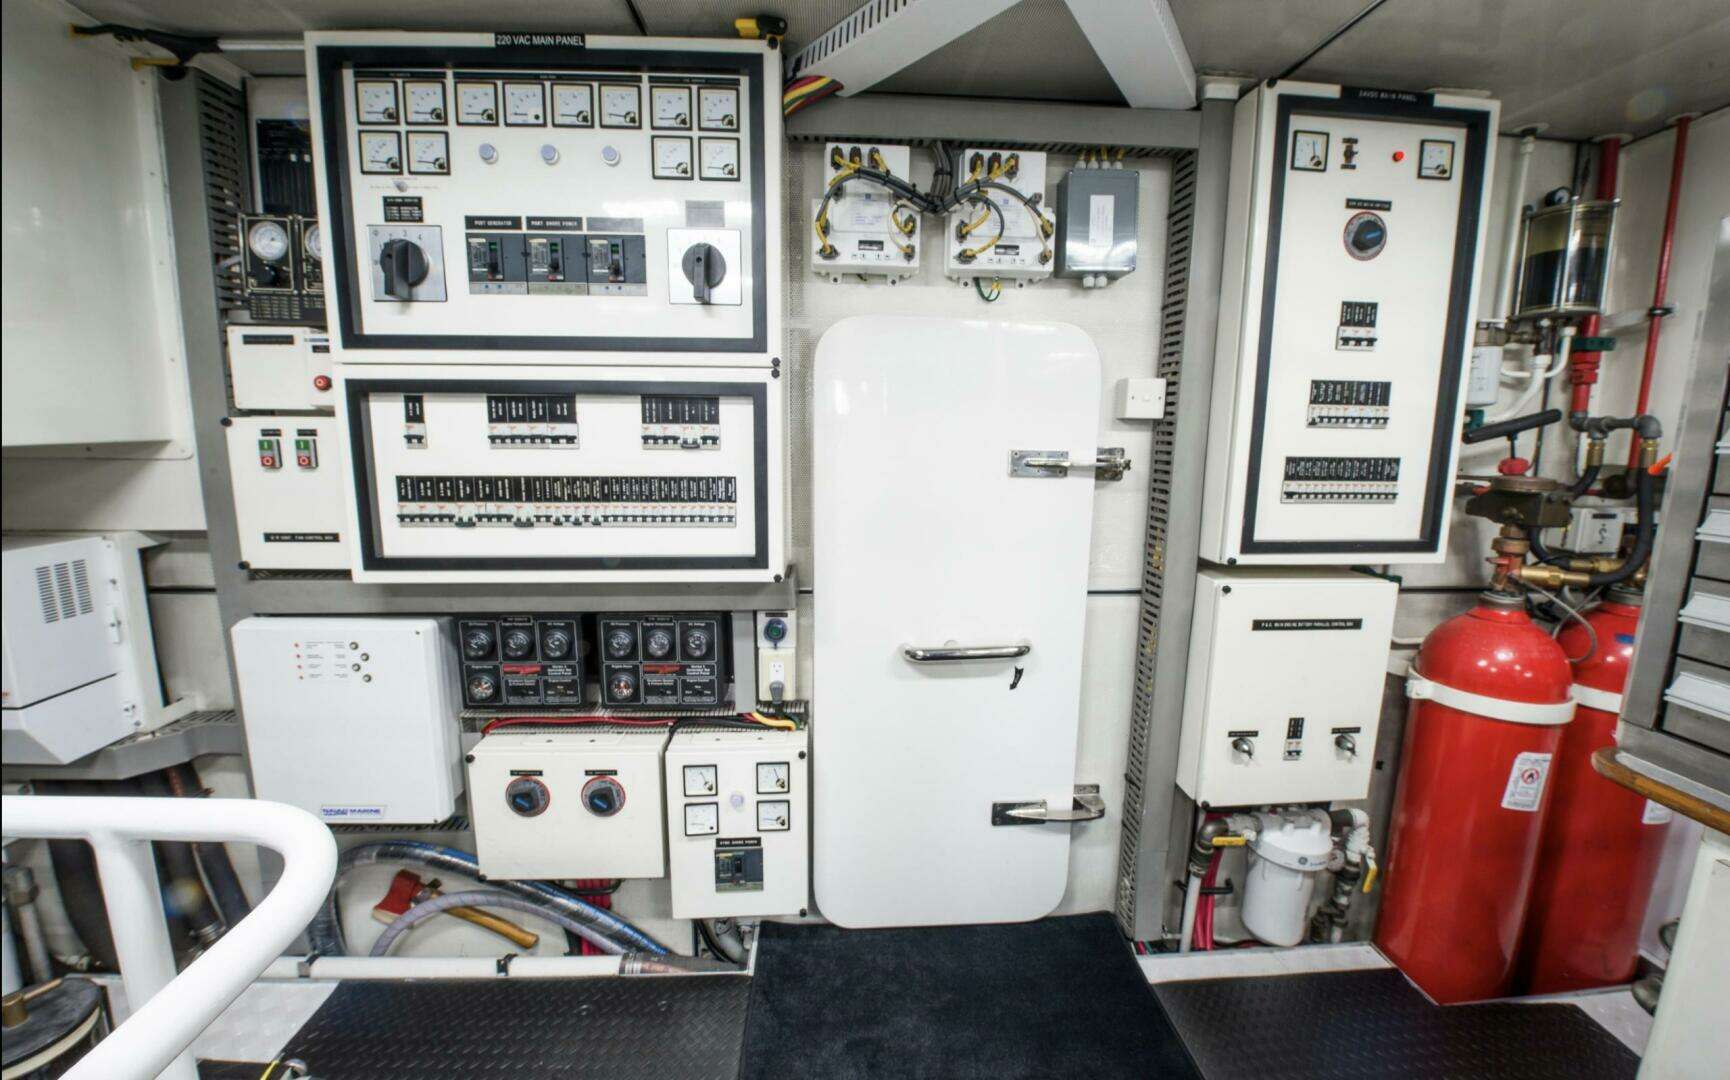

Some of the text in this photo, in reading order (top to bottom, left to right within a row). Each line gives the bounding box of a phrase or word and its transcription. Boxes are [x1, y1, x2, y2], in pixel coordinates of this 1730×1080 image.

[497, 35, 584, 46] 220 VAC MAIN PANEL
